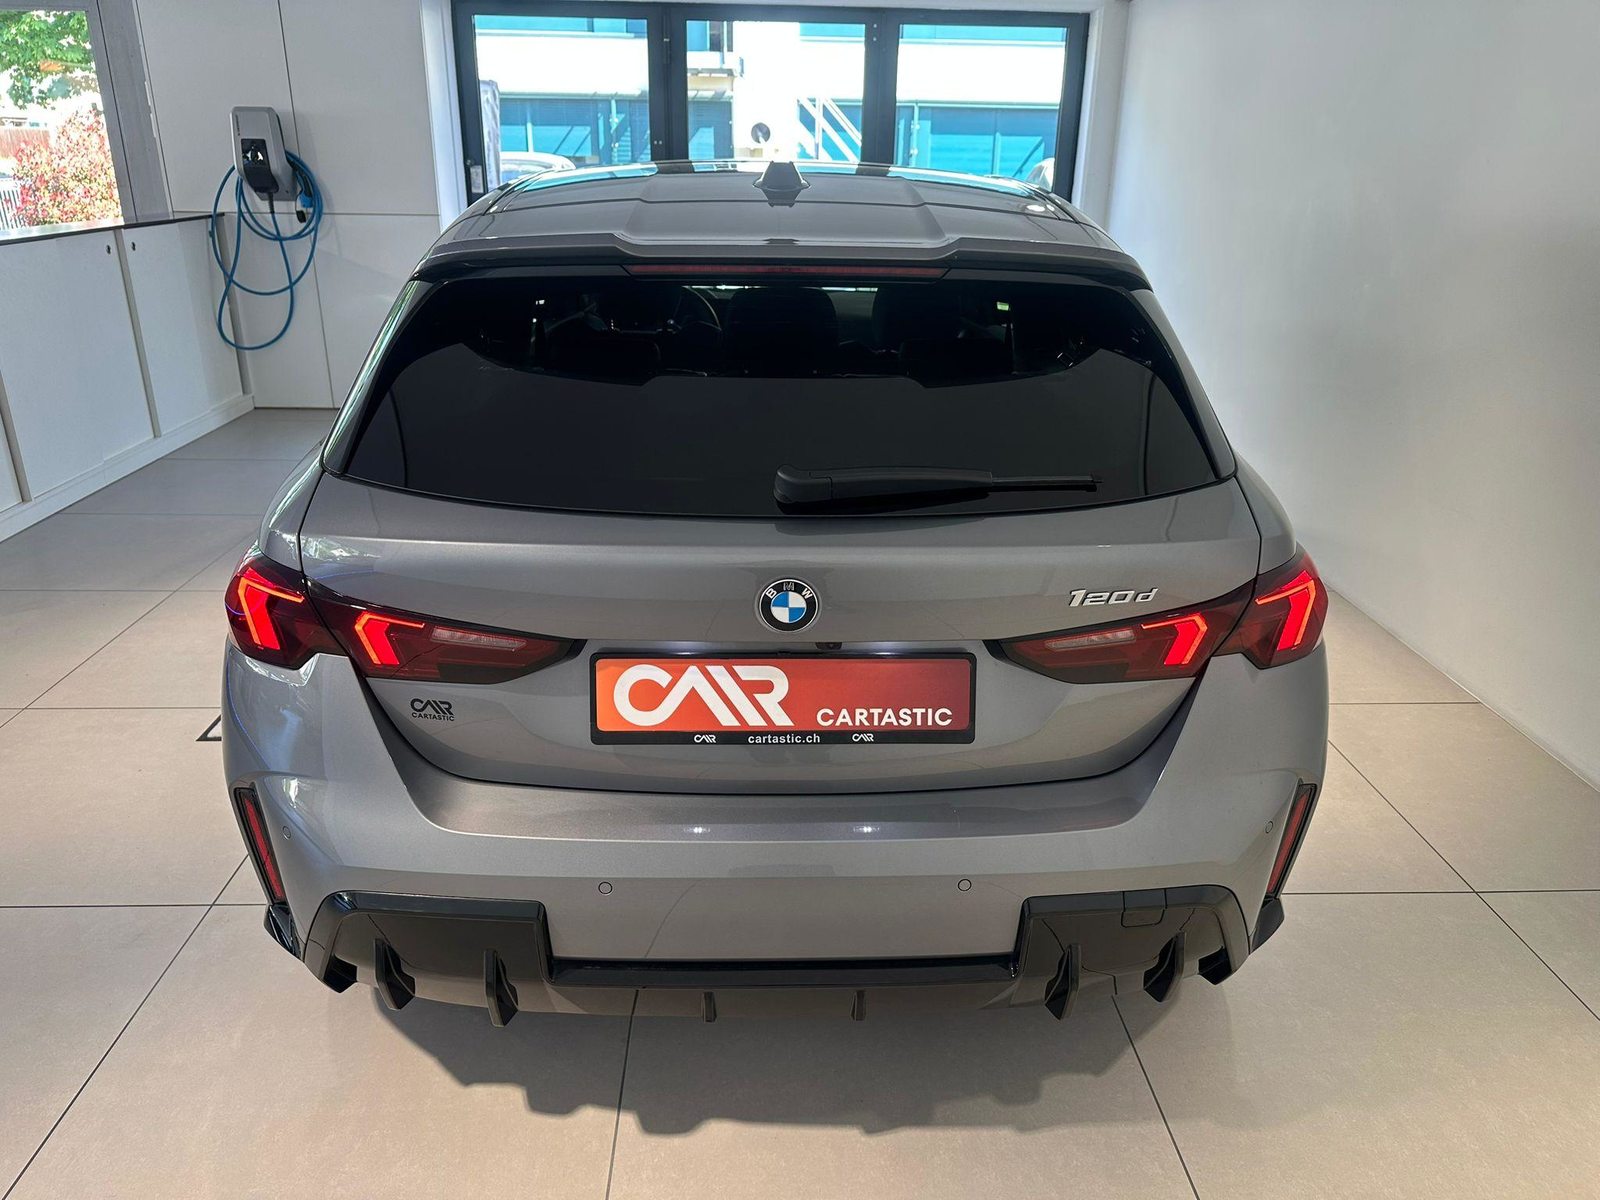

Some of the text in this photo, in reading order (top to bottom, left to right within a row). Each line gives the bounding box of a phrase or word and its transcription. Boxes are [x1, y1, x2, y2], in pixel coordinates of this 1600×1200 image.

[765, 582, 813, 599] BMW
[1069, 588, 1158, 607] 120d
[411, 712, 455, 721] CARTASTIC
[816, 708, 953, 726] CARTASTIC
[748, 733, 821, 744] cartastic.ch
